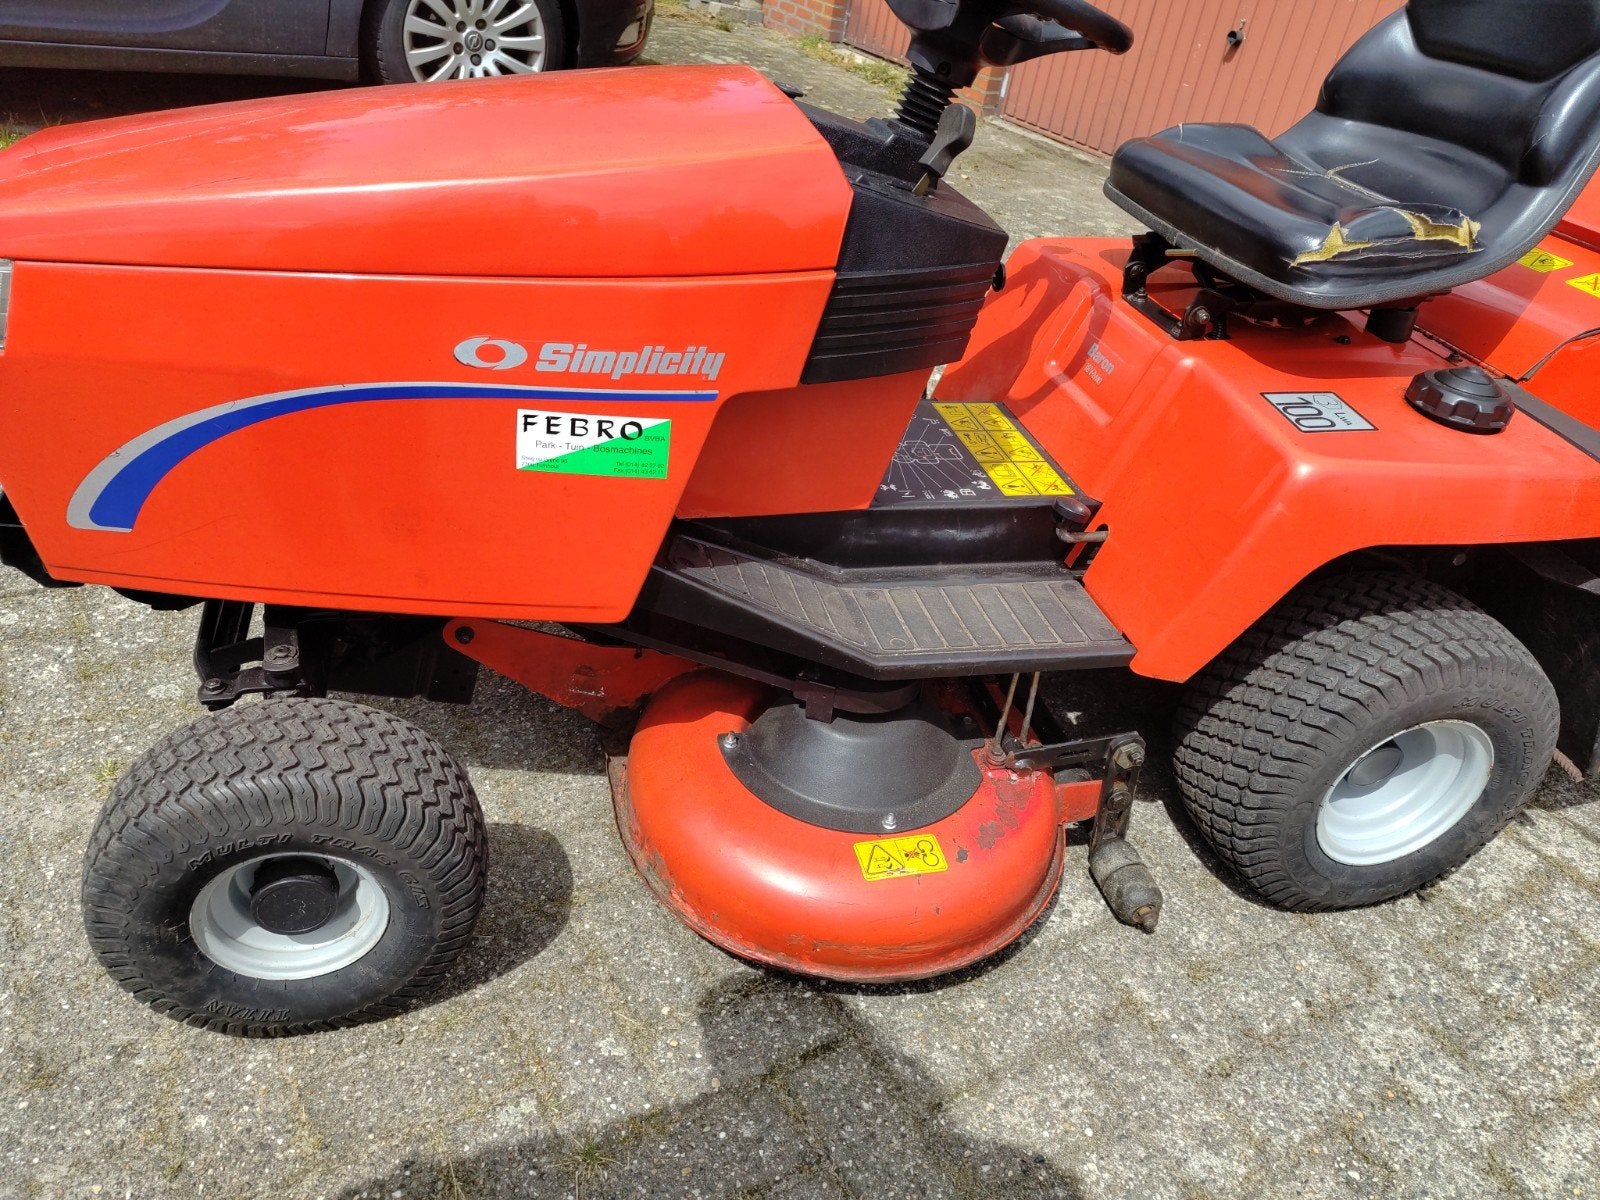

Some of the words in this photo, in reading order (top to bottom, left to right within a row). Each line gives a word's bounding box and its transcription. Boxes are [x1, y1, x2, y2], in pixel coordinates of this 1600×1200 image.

[535, 342, 725, 380] Simplicity
[522, 413, 643, 441] FEBRO
[1275, 396, 1337, 429] 100
[535, 440, 556, 450] Park
[565, 442, 584, 452] Tuin
[593, 444, 653, 455] Bosmachines
[188, 833, 293, 871] MULTI
[311, 833, 397, 866] TRAC
